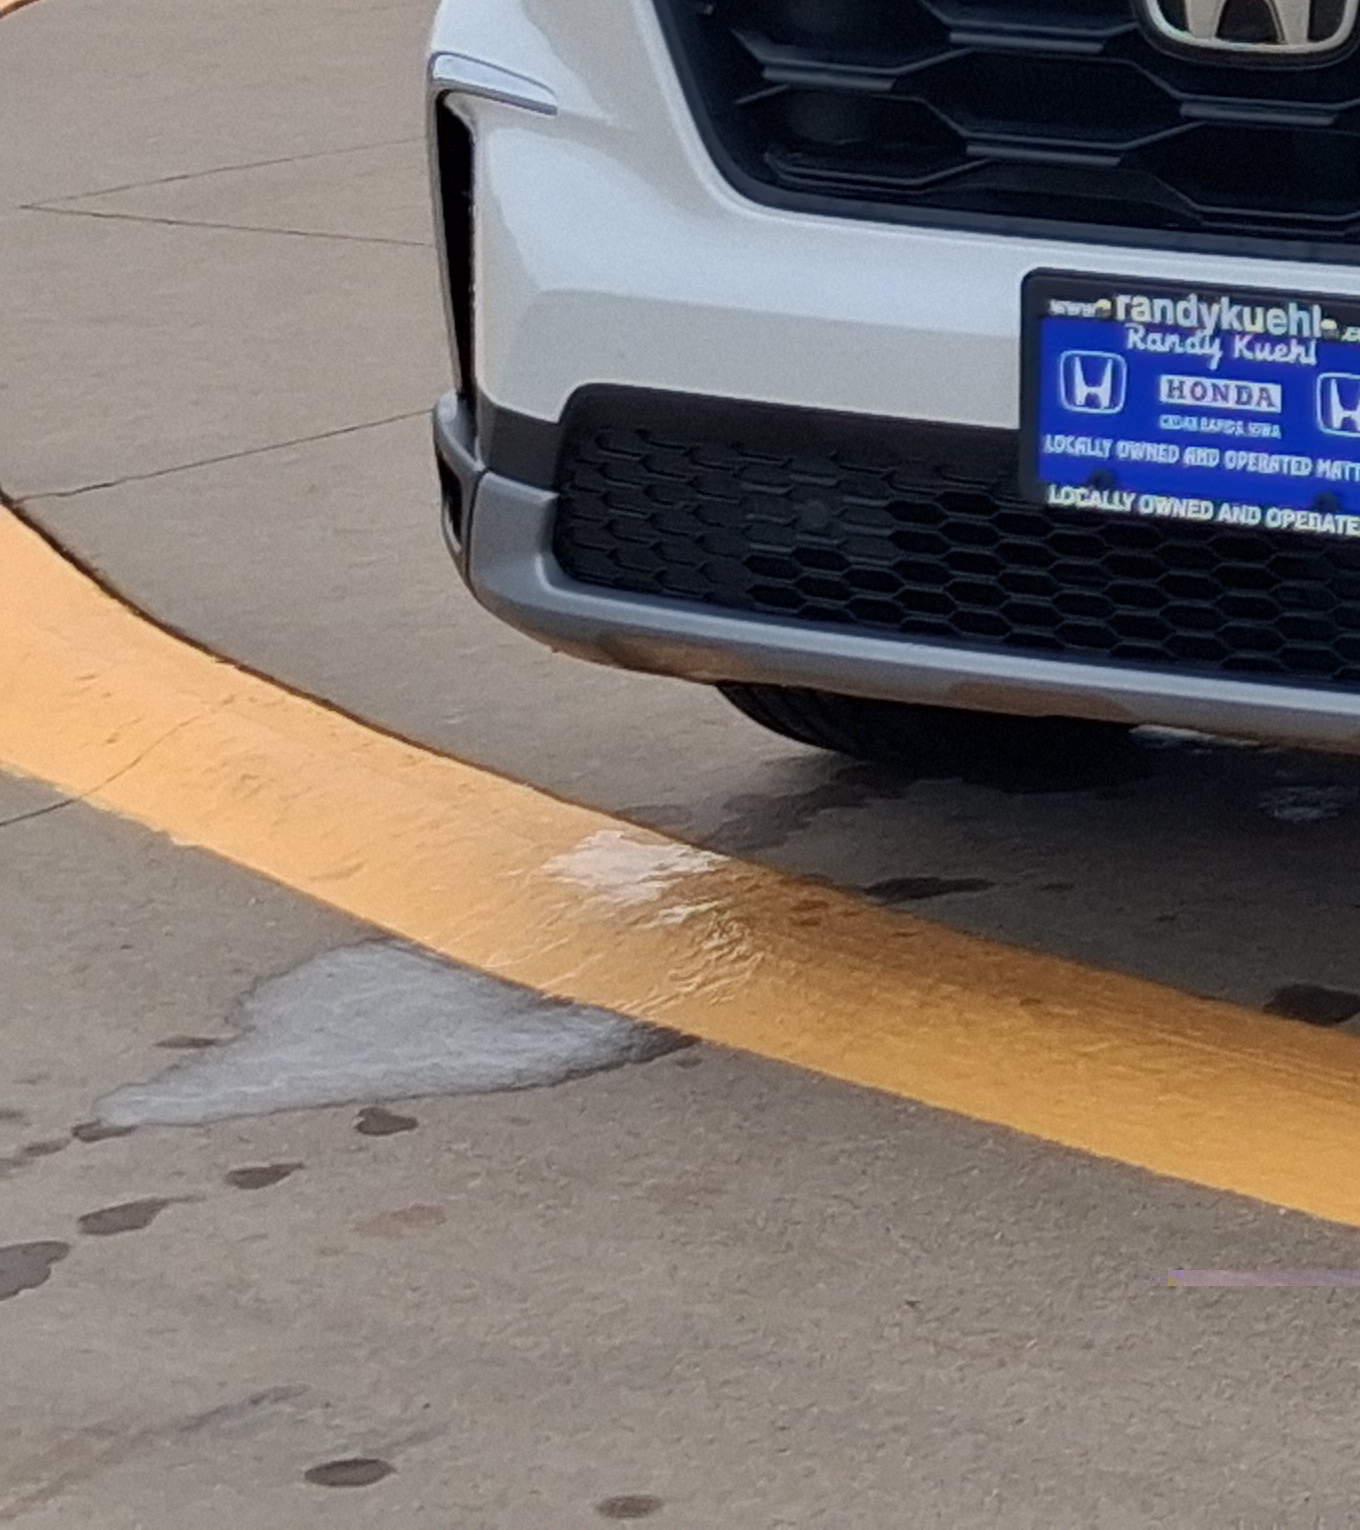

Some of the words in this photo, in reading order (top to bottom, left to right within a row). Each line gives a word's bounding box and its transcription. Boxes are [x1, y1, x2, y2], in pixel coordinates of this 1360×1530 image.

[1116, 292, 1321, 338] randykuehl
[1125, 323, 1222, 369] Randy
[1233, 331, 1318, 366] Kuehl
[1165, 378, 1277, 409] HONDA
[1044, 433, 1113, 460] LOCALLY
[1117, 440, 1180, 465] OWNED
[1183, 445, 1220, 468] AND
[1225, 449, 1313, 477] OPERATED
[1048, 484, 1136, 514] LOCALLY
[1140, 494, 1214, 522] OWNED
[1218, 501, 1261, 526] AND
